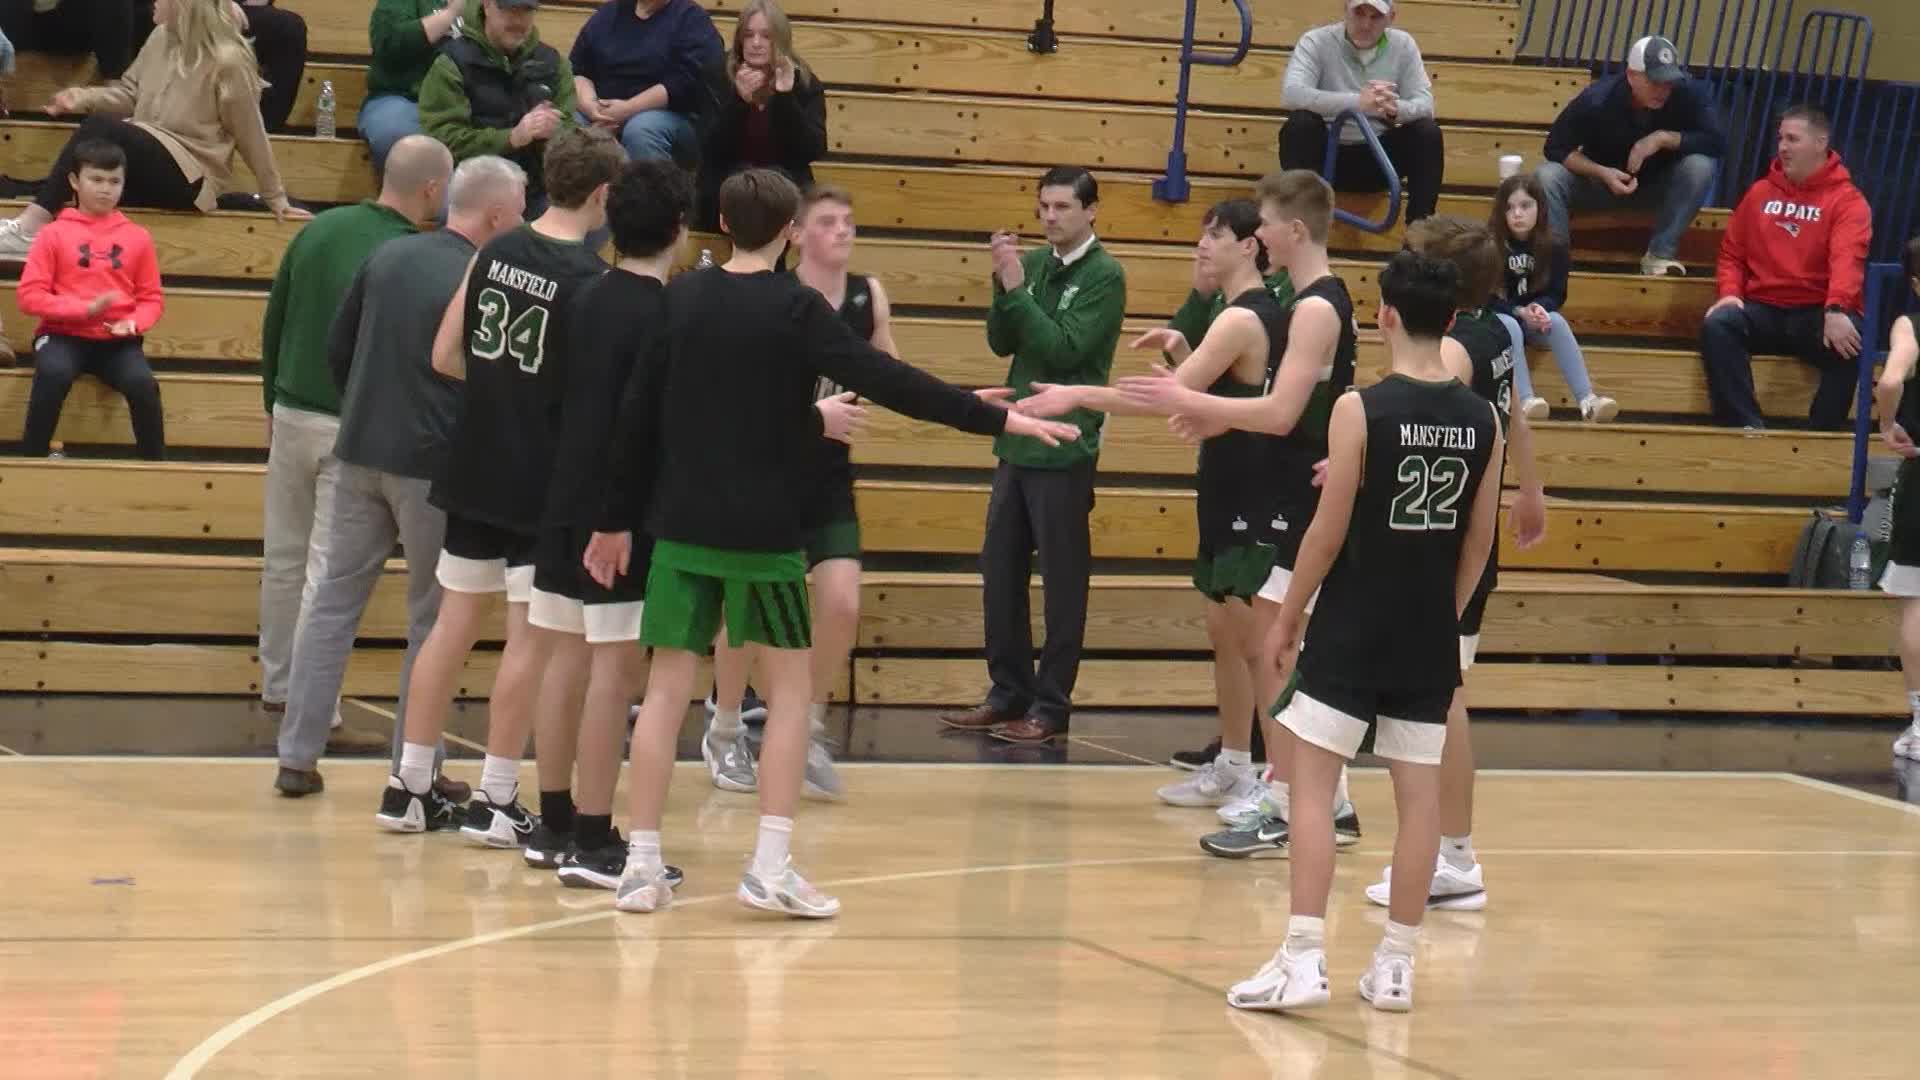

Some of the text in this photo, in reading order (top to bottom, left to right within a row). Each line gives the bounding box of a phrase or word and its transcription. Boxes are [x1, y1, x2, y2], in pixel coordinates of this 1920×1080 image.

[1784, 203, 1822, 222] PATS
[487, 259, 558, 301] MANSFIELD
[471, 287, 549, 374] 34
[1400, 423, 1475, 450] MANSFIELD
[1389, 455, 1470, 530] 22
